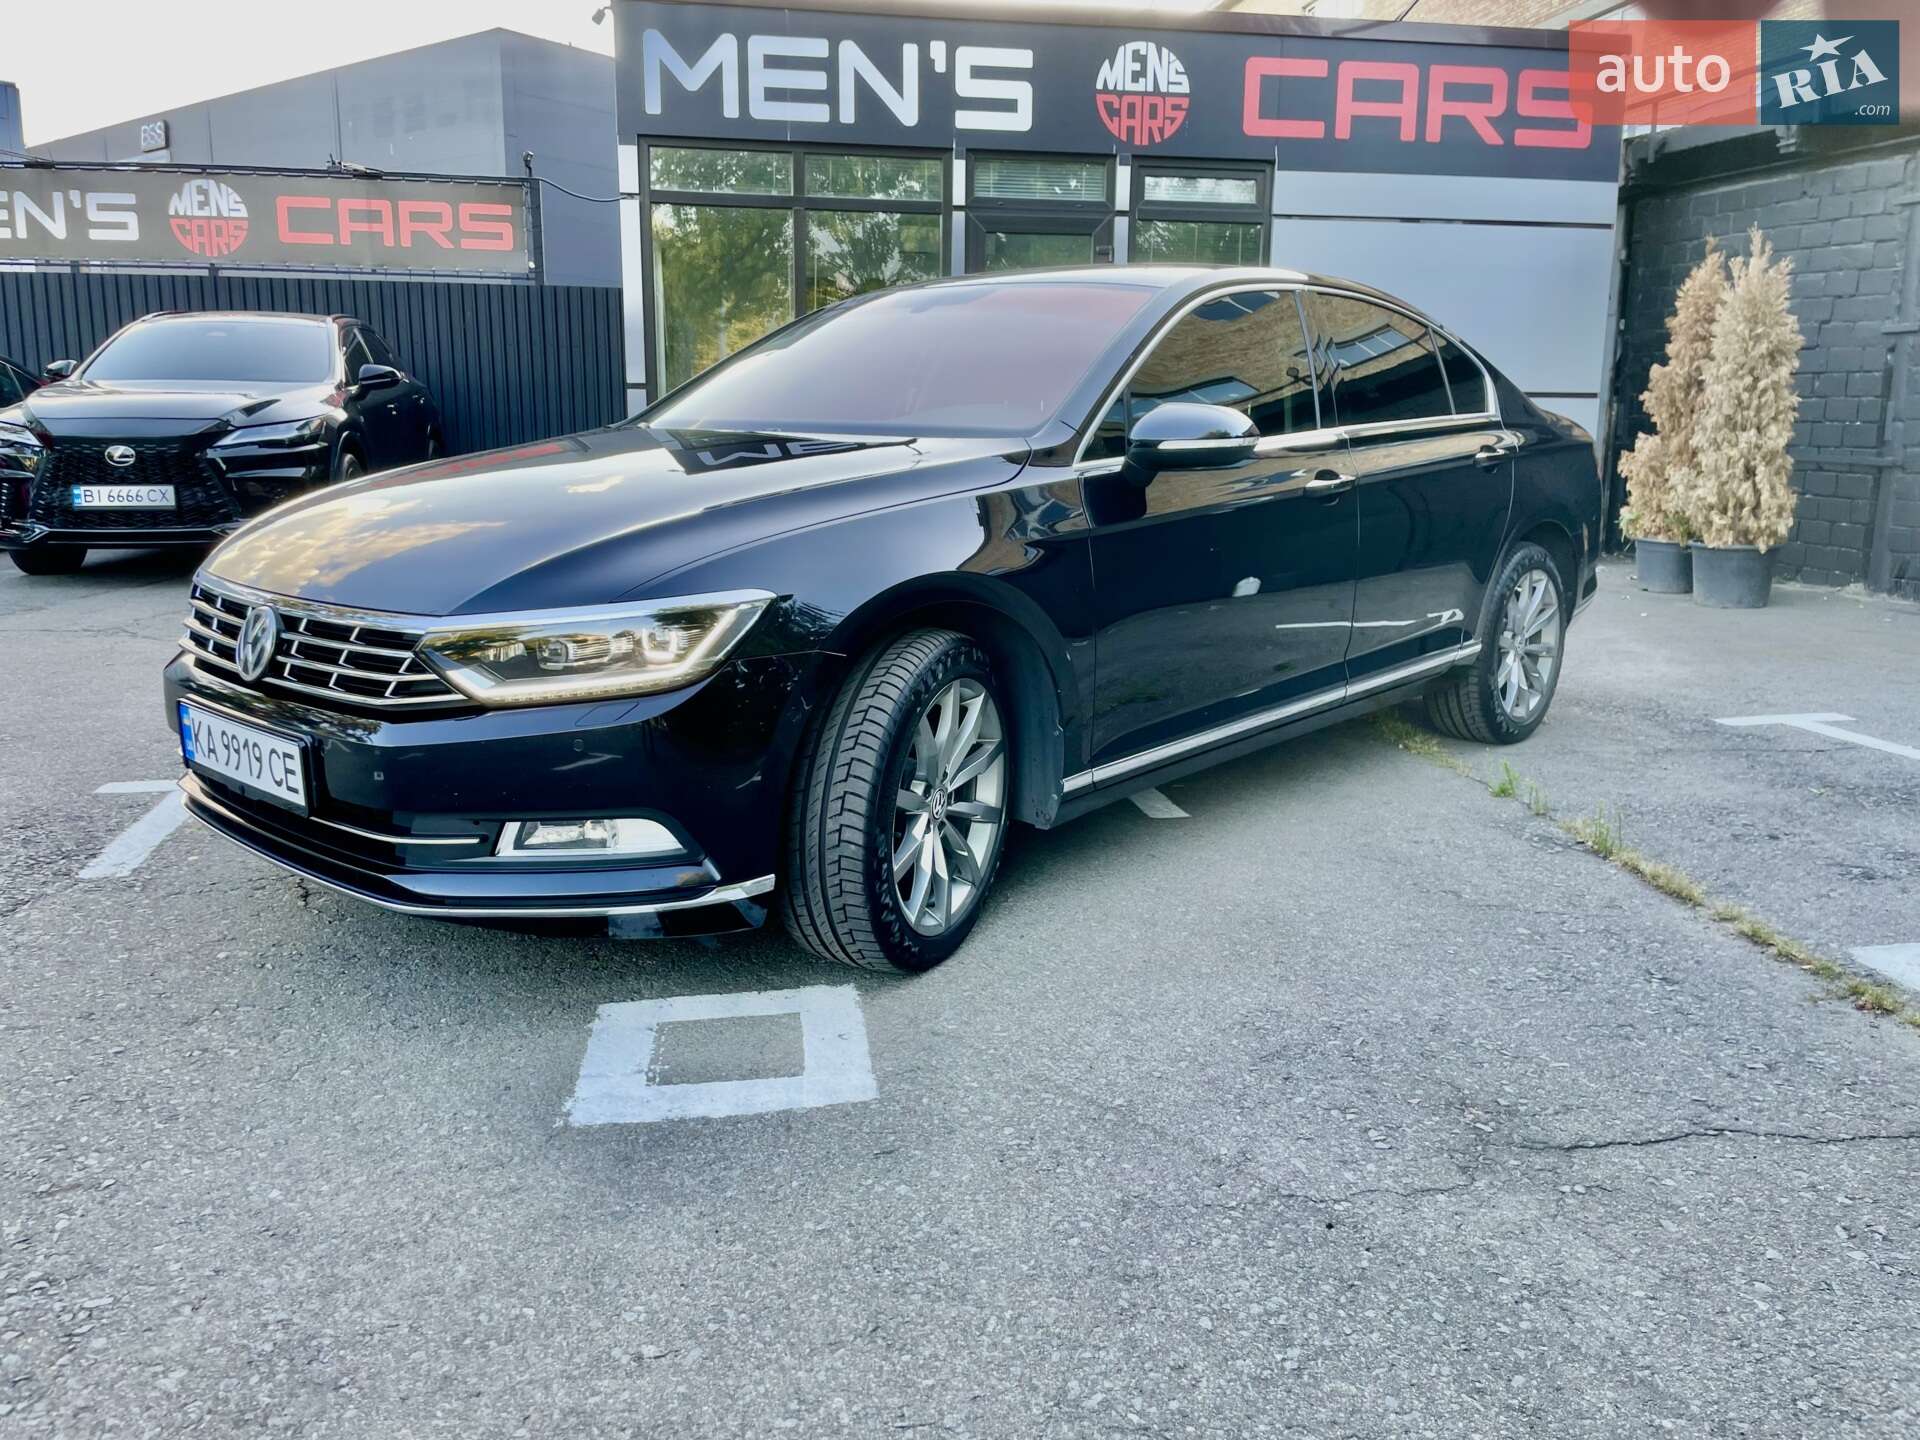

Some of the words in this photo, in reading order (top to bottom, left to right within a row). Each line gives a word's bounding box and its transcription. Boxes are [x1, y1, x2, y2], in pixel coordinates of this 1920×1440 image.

[643, 29, 1033, 132] MEN'S
[1243, 56, 1594, 149] CARS
[1096, 41, 1190, 93] MEN'S
[1096, 94, 1190, 145] CARS
[0, 190, 139, 241] N'S
[276, 196, 514, 251] CARS
[168, 179, 248, 217] MEN'S
[169, 218, 248, 256] CARS
[83, 489, 101, 503] BI
[107, 489, 144, 503] 6666
[147, 489, 169, 503] CX
[192, 718, 219, 763] KA
[221, 730, 263, 780] 9919
[268, 747, 300, 794] CE
